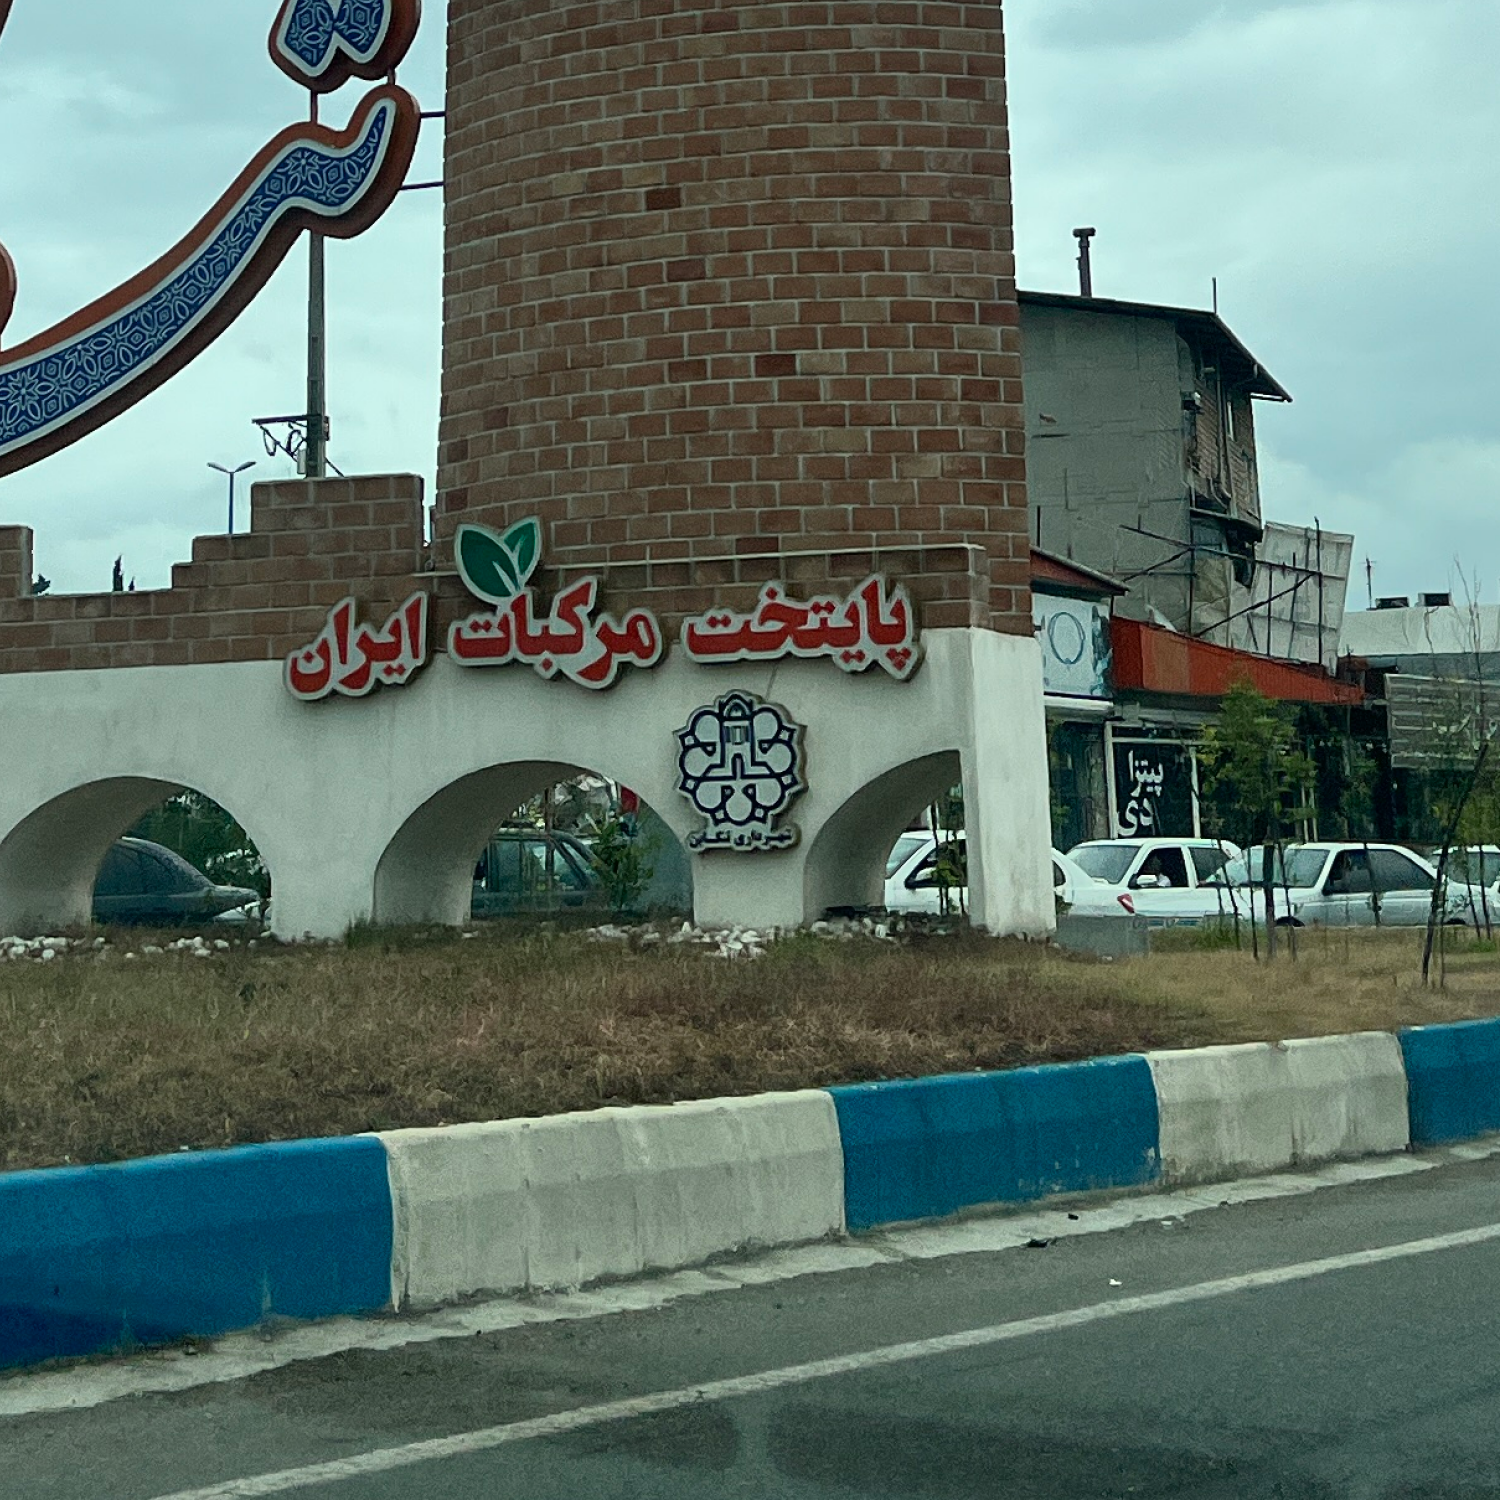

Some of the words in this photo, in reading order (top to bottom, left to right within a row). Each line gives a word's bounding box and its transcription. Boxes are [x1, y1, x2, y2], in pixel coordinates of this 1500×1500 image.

[288, 595, 425, 696] ایران
[451, 577, 660, 683] مرکبات
[685, 575, 916, 676] پایتخت
[1127, 749, 1165, 798] پیتزا
